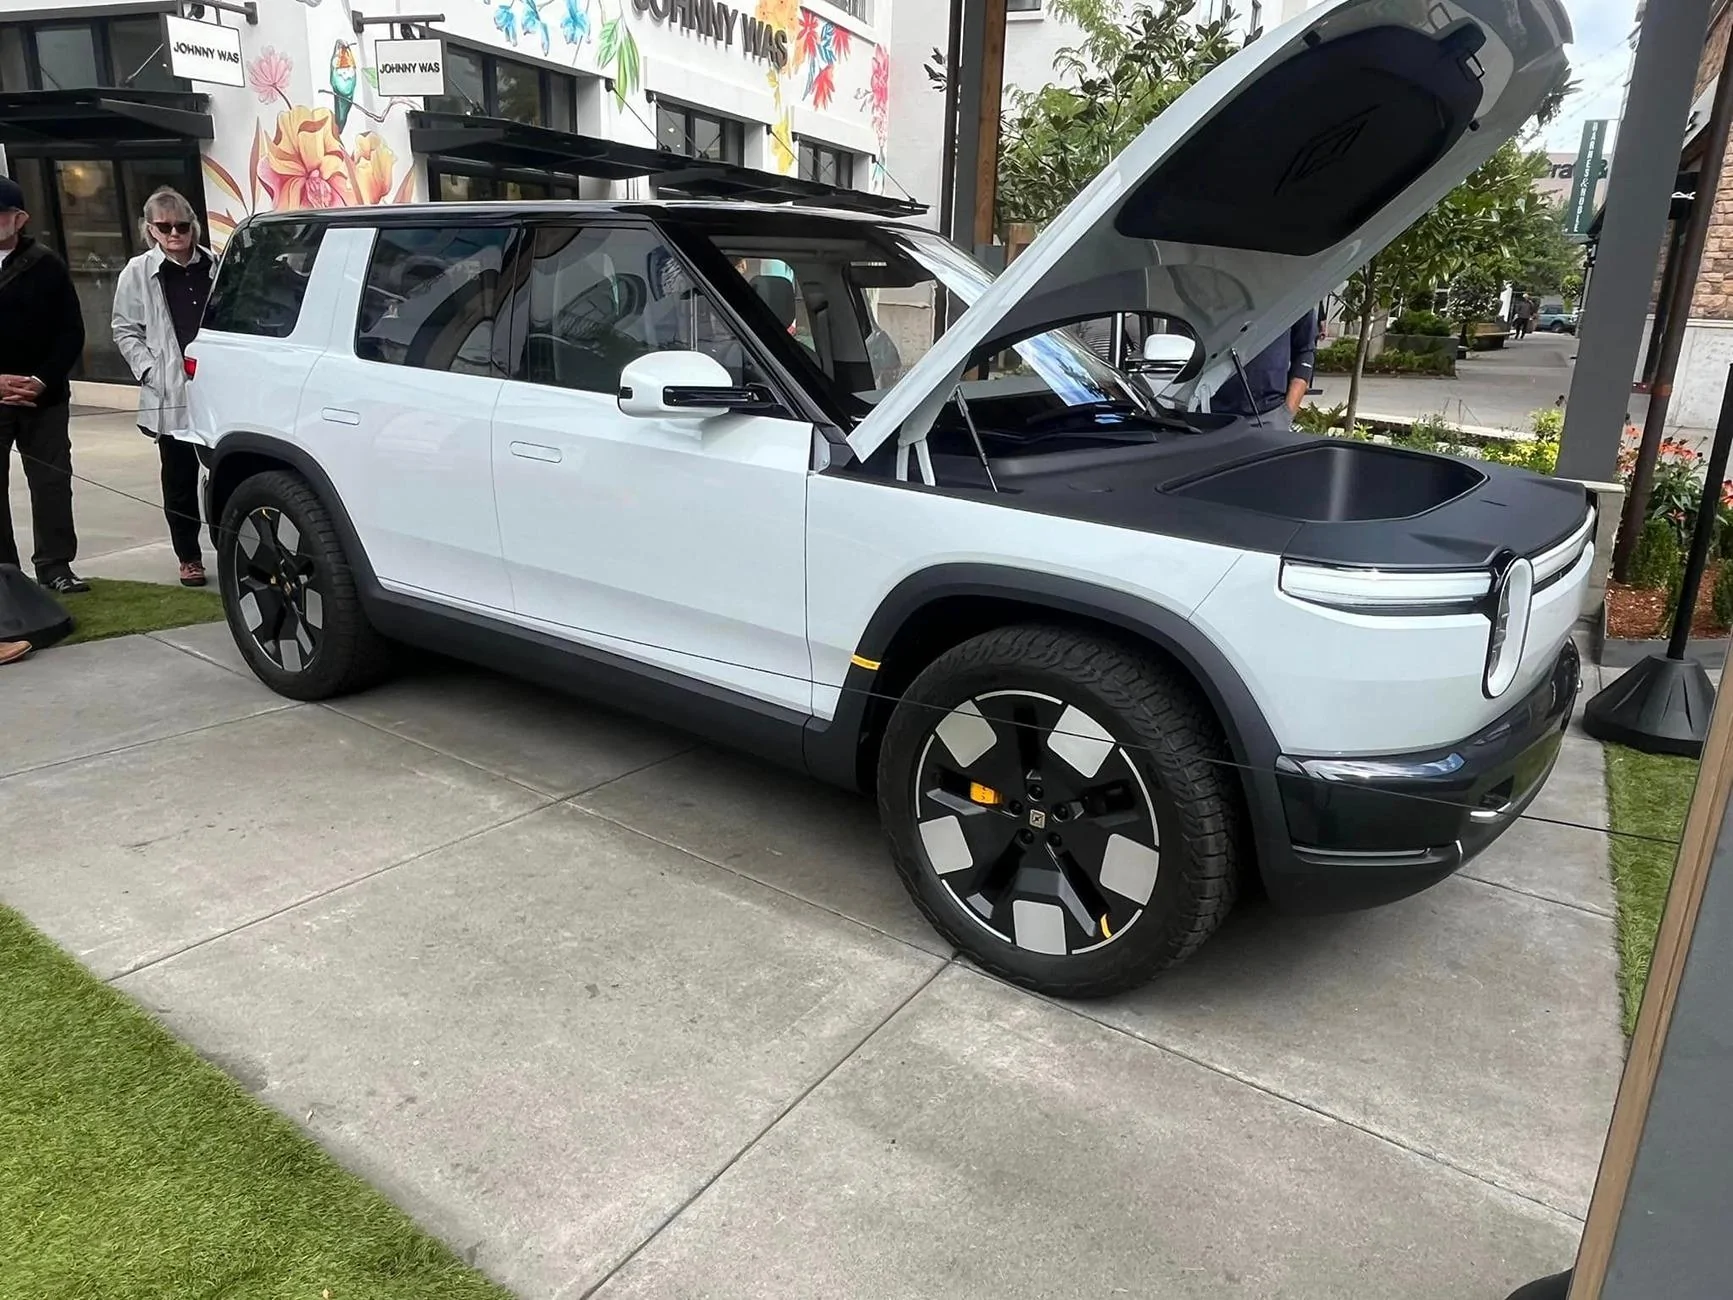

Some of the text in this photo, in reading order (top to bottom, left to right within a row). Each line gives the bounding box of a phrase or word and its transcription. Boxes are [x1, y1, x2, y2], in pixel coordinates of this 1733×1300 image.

[742, 13, 788, 69] WAS
[173, 42, 240, 64] JOHNNY WAS
[380, 62, 440, 74] JOHNNY WAS
